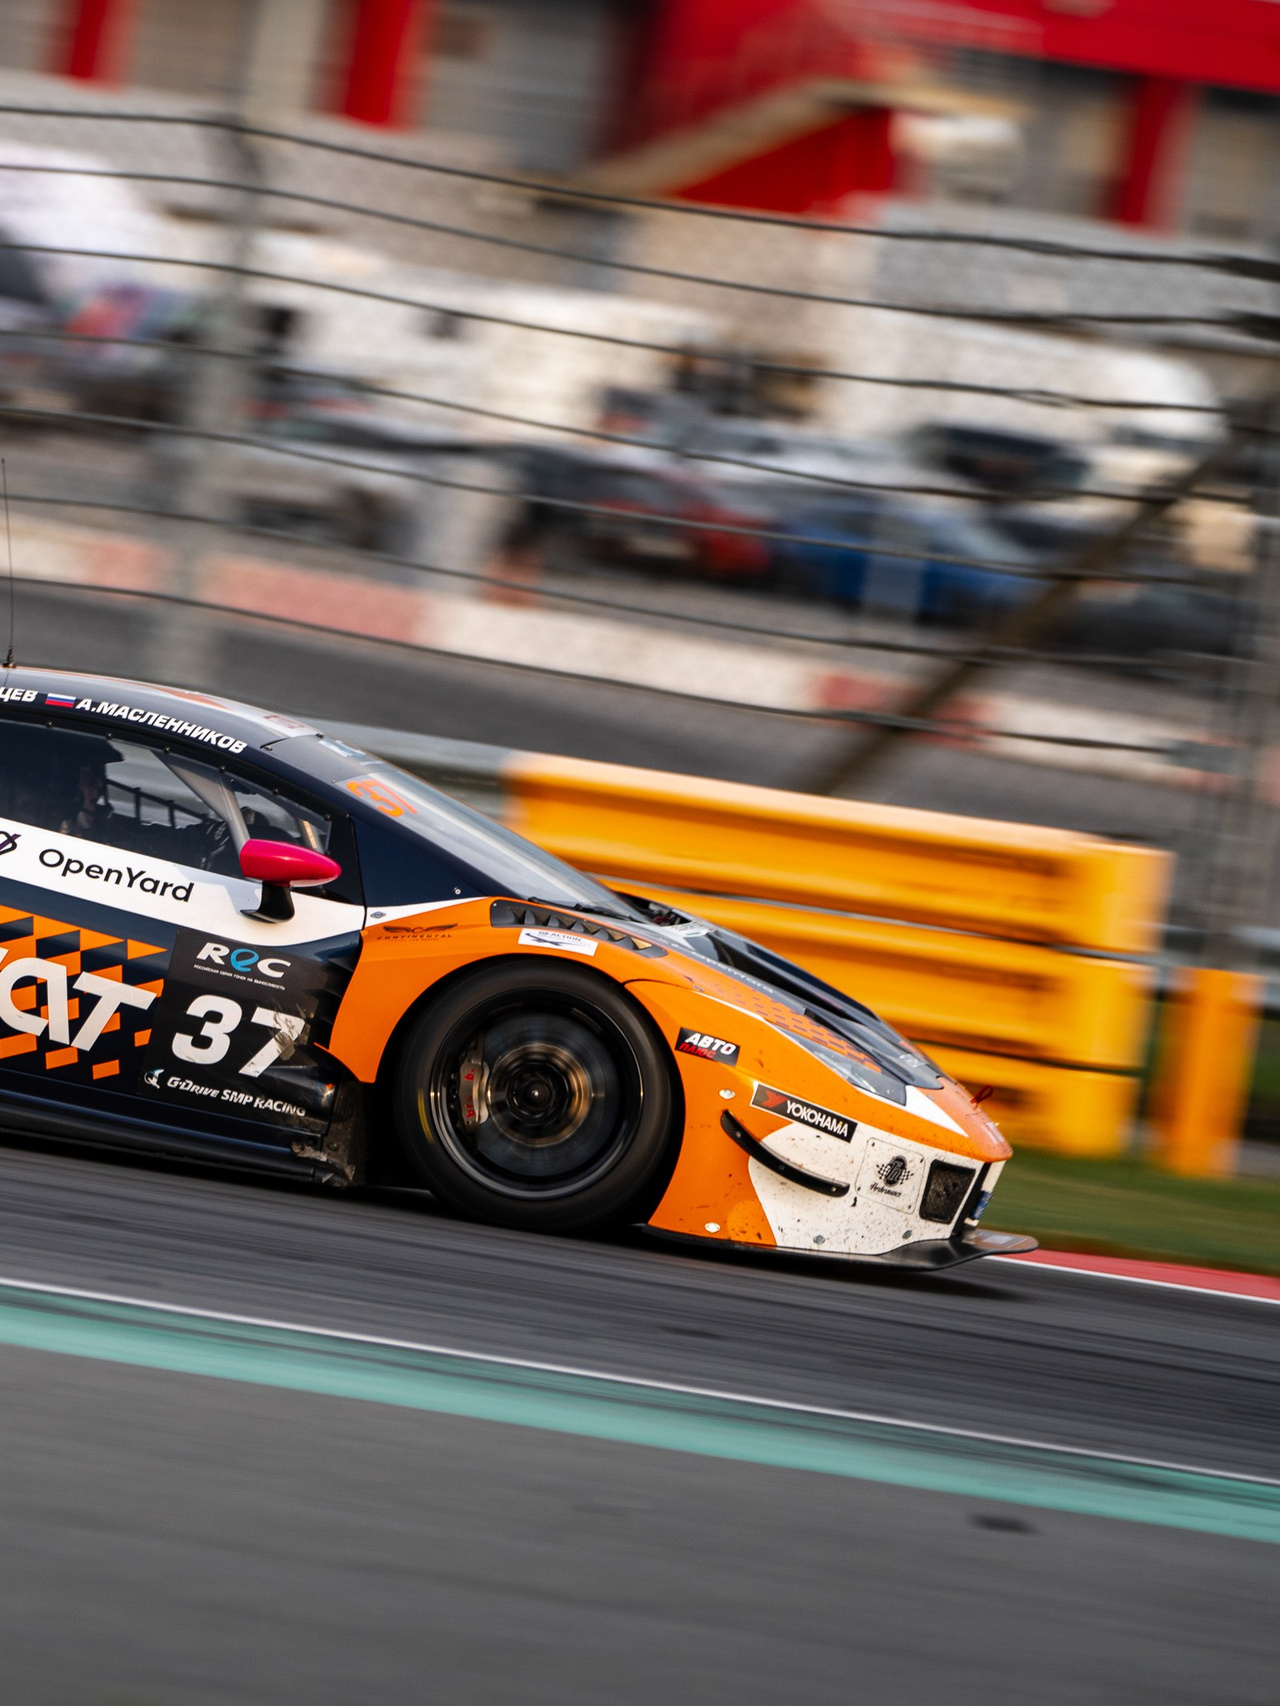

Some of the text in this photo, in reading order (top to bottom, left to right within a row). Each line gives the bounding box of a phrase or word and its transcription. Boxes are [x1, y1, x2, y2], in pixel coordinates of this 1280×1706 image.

[75, 698, 248, 754] А.МАСЛЕННИКОВ
[38, 848, 195, 903] OpenYard
[171, 994, 306, 1078] 37
[684, 1032, 737, 1056] АВТО
[221, 1089, 254, 1105] SMP
[786, 1100, 849, 1138] YOKOHAMA
